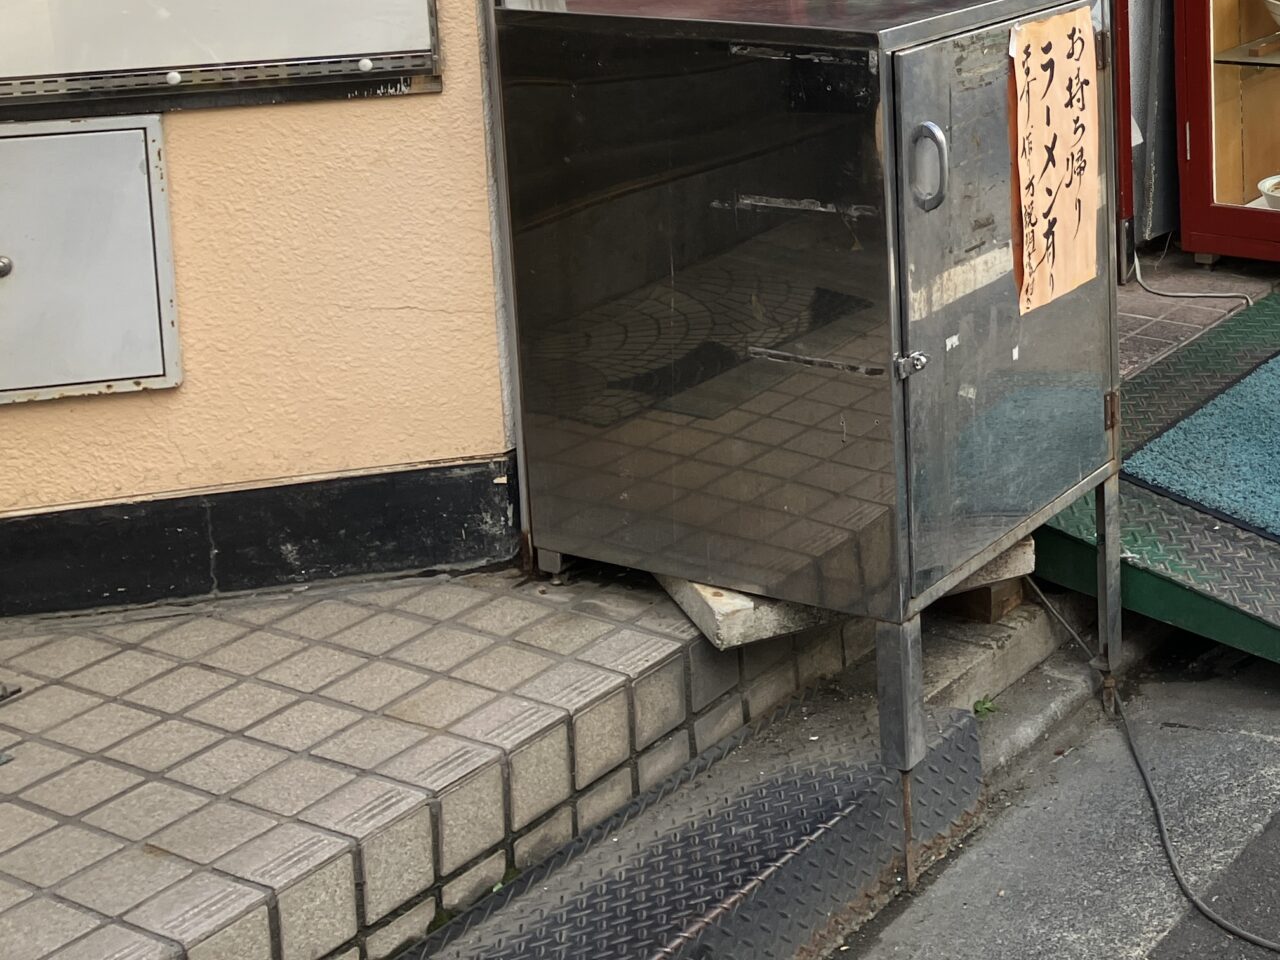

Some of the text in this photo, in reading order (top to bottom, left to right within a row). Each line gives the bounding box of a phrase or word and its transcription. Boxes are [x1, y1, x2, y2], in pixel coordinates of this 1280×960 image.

[1064, 26, 1090, 241] お持ち帰り
